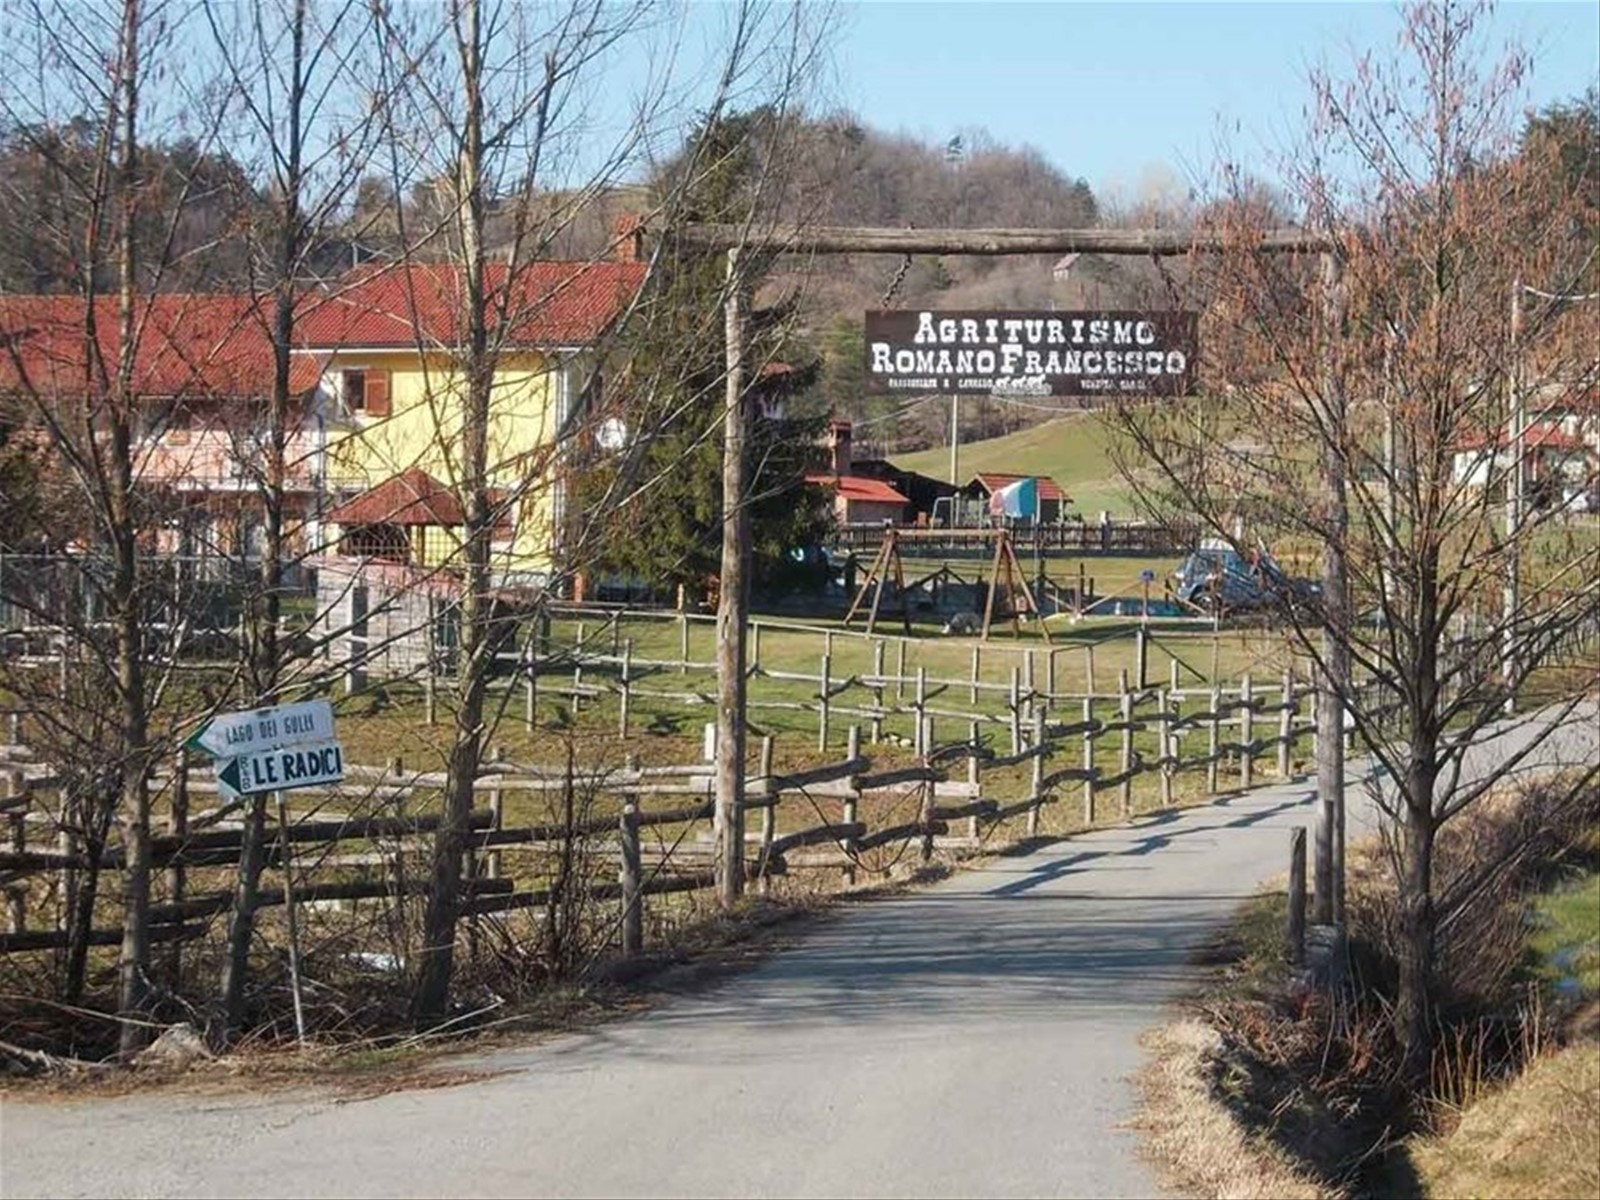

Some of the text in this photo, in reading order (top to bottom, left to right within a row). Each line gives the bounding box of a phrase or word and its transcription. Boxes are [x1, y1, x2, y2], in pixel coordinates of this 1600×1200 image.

[914, 312, 1155, 345] AGRITURISMO
[871, 343, 1187, 375] ROMANO FRANCESCO
[226, 723, 253, 744] LAGO
[260, 719, 277, 739] DEI
[253, 747, 342, 785] LE RADICI
